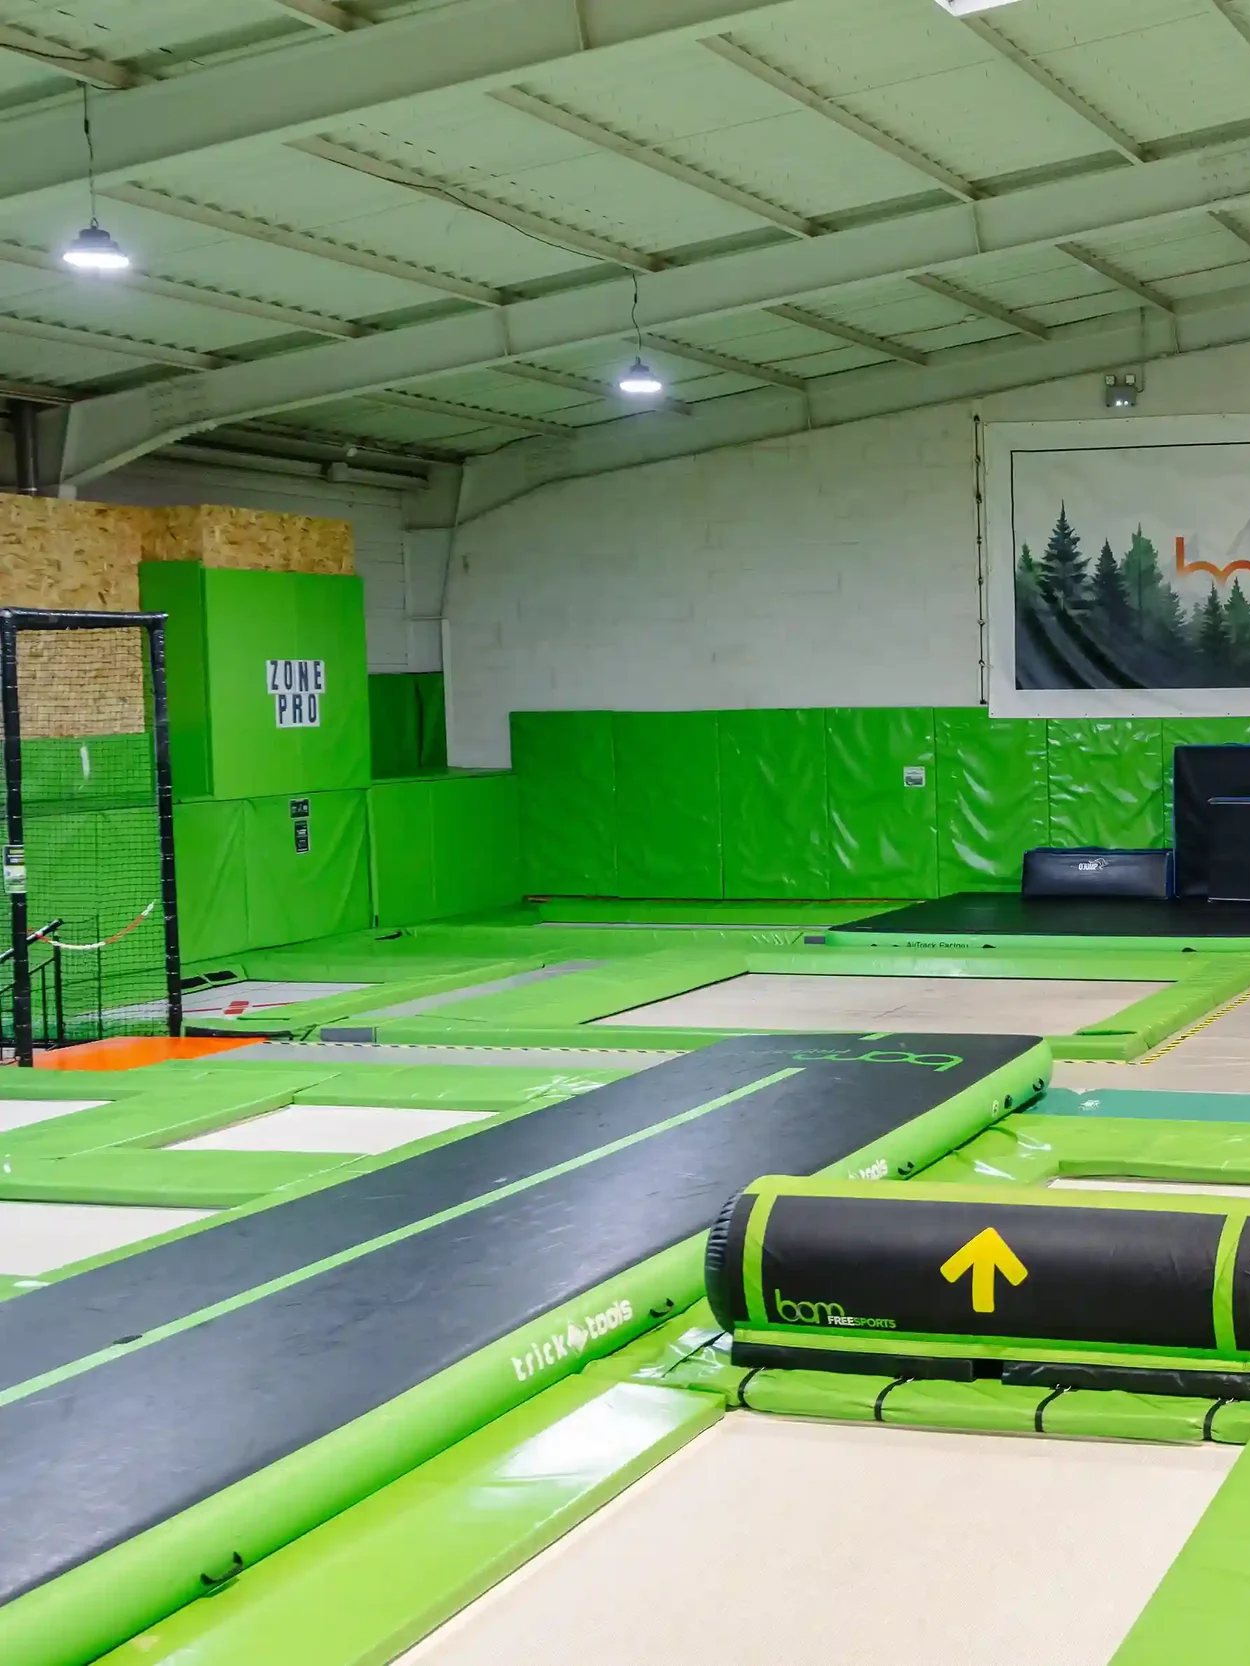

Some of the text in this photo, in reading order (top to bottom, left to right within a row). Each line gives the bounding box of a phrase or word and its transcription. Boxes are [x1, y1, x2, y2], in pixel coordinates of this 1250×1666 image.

[270, 660, 322, 692] ZONE
[279, 694, 317, 724] PRO
[775, 1288, 897, 1329] bam FREESPORTS
[510, 1299, 633, 1382] trick tools
